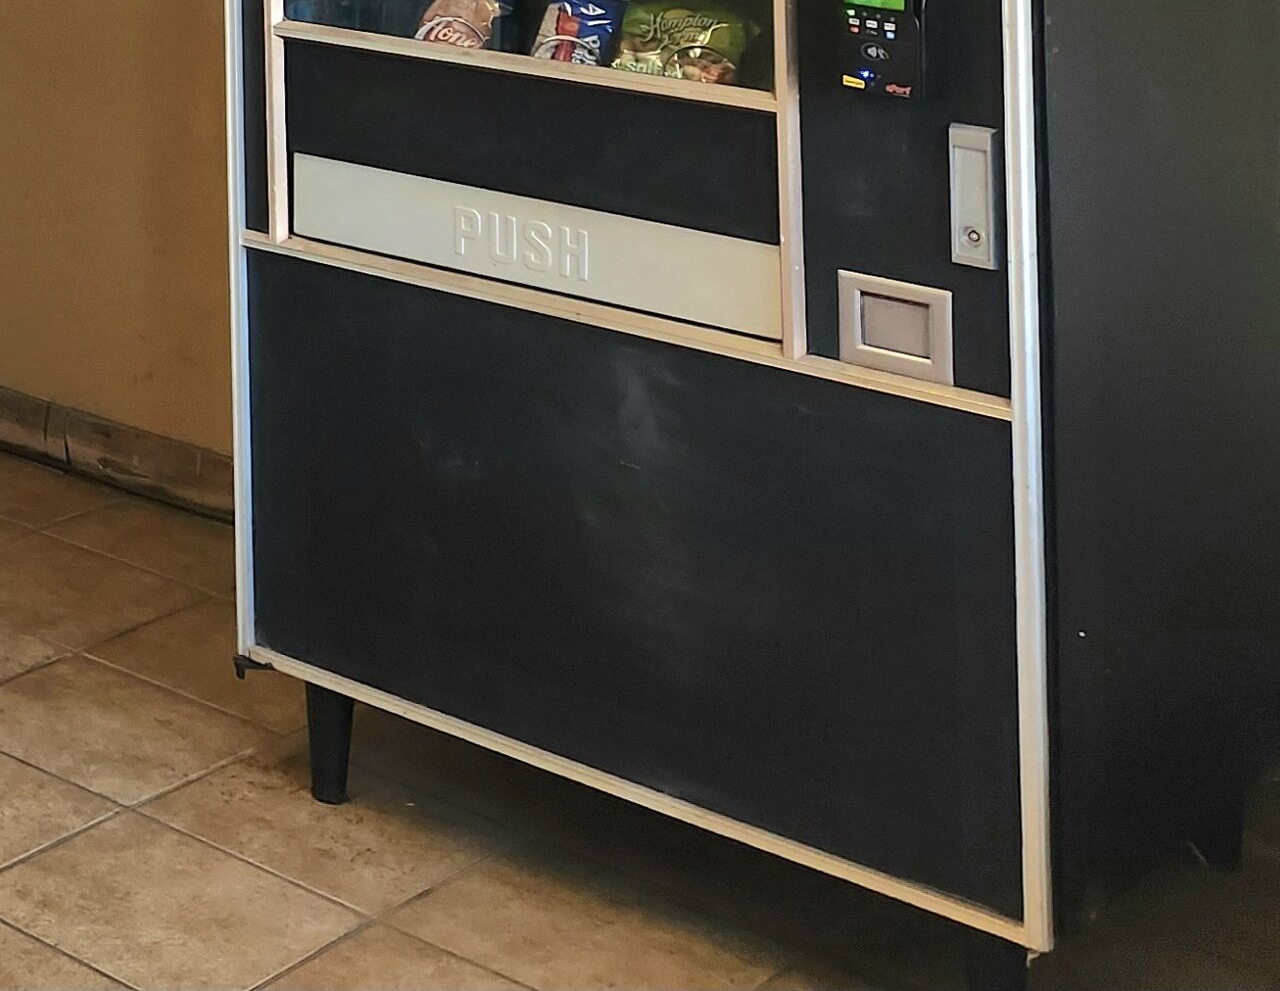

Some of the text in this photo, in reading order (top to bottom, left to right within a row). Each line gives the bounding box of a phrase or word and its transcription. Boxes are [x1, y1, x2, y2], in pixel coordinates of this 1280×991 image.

[640, 10, 718, 43] Hampton
[658, 28, 705, 53] Farm
[453, 205, 590, 282] PUSH
